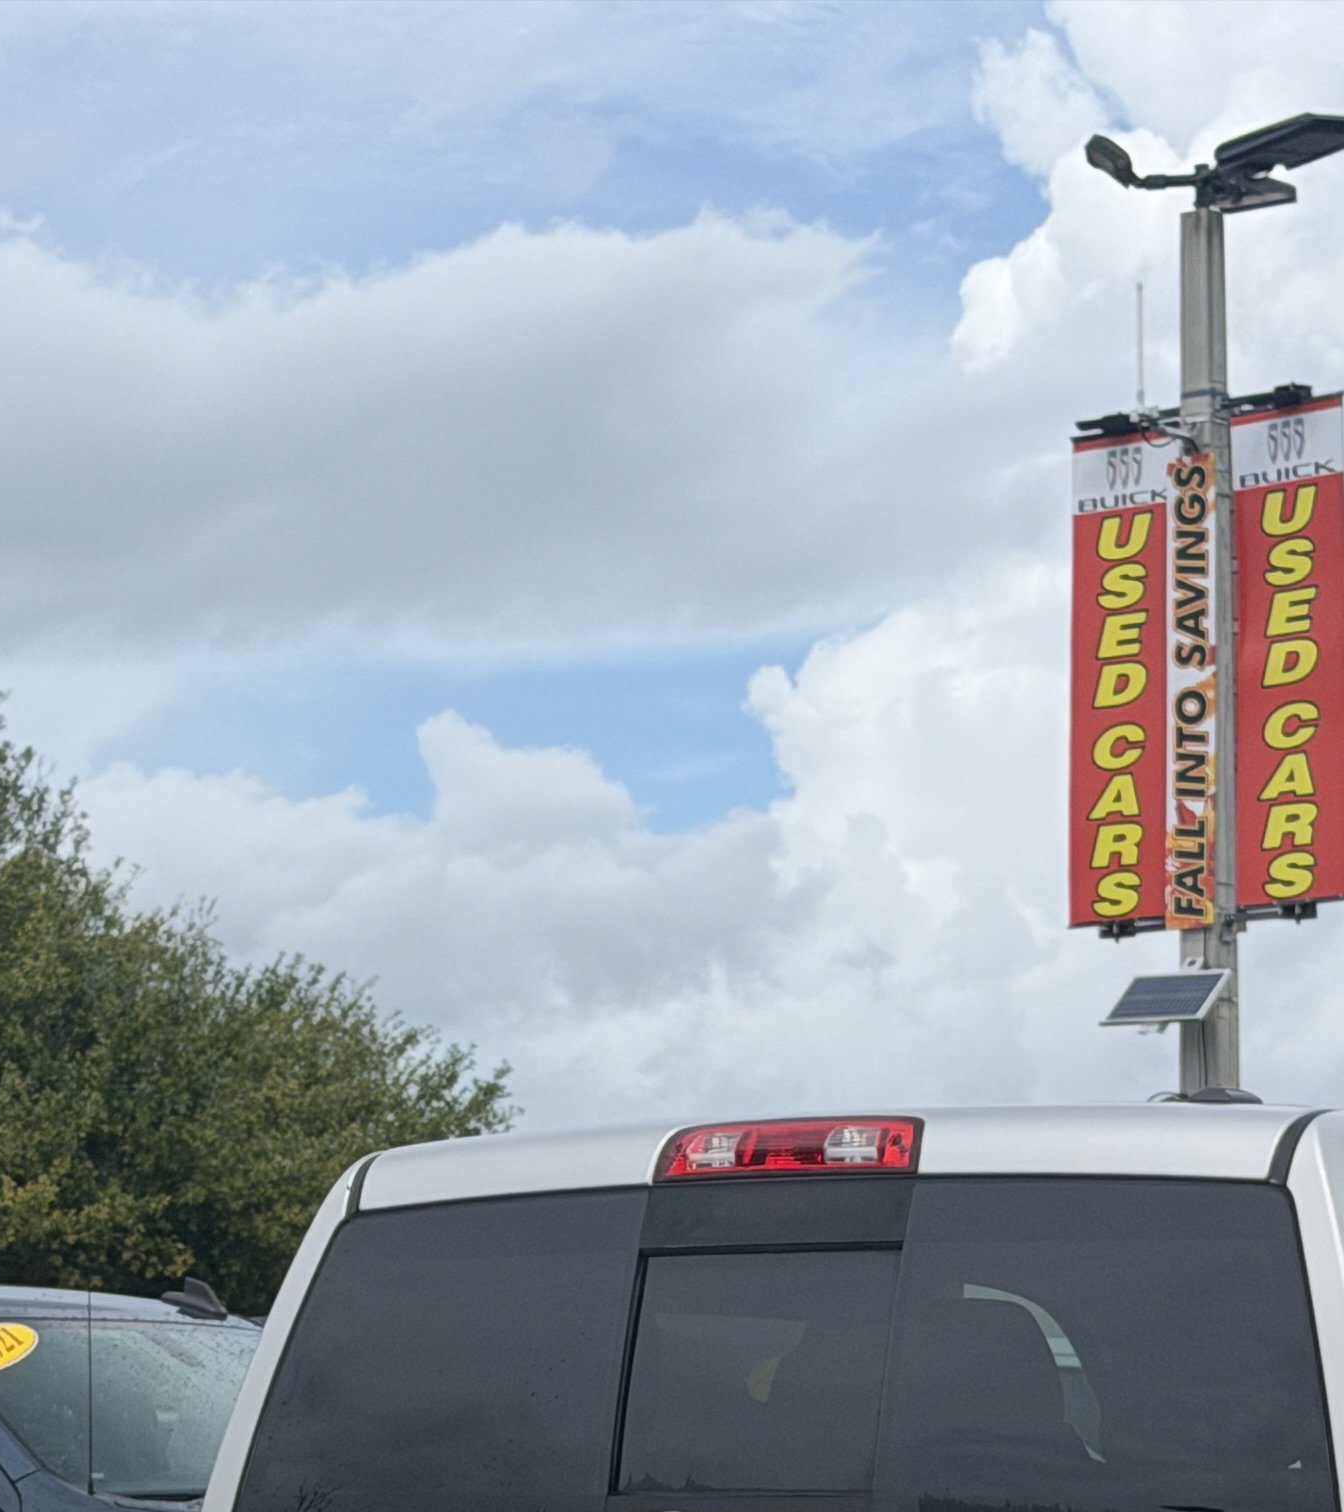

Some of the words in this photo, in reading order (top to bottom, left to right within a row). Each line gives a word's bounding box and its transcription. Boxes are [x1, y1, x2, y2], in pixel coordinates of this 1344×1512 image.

[1078, 488, 1168, 513] BUICK
[1173, 464, 1207, 667] SAVINGS
[1239, 460, 1336, 489] BUICK
[1092, 512, 1153, 710] USED
[1260, 485, 1319, 688] USED
[1087, 724, 1146, 917] CARS
[1174, 688, 1207, 798] INTO
[1259, 702, 1320, 899] CARS
[1172, 818, 1206, 918] FALL
